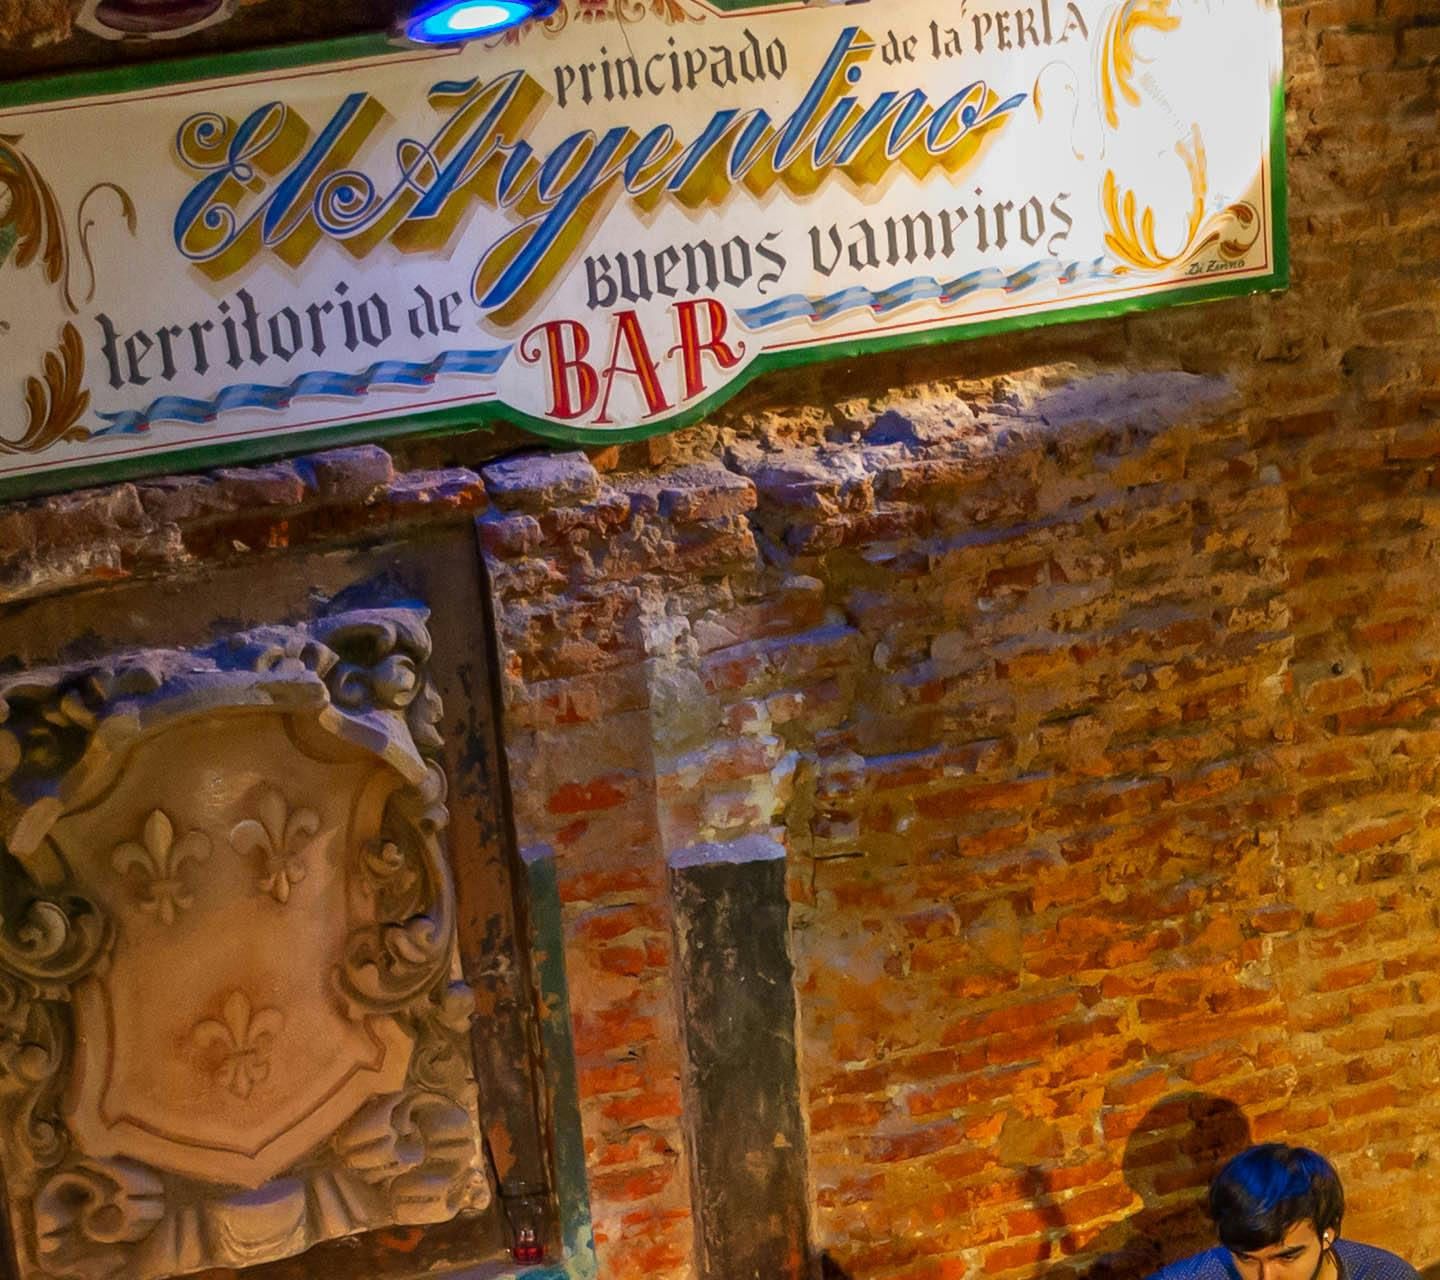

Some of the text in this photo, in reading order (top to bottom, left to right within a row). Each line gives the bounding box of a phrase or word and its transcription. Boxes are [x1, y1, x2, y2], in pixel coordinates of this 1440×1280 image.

[553, 27, 788, 109] principado
[881, 29, 918, 65] de
[929, 19, 962, 60] la
[172, 26, 1028, 310] El Argentino
[94, 280, 463, 390] territorio de
[520, 296, 746, 425] BAR
